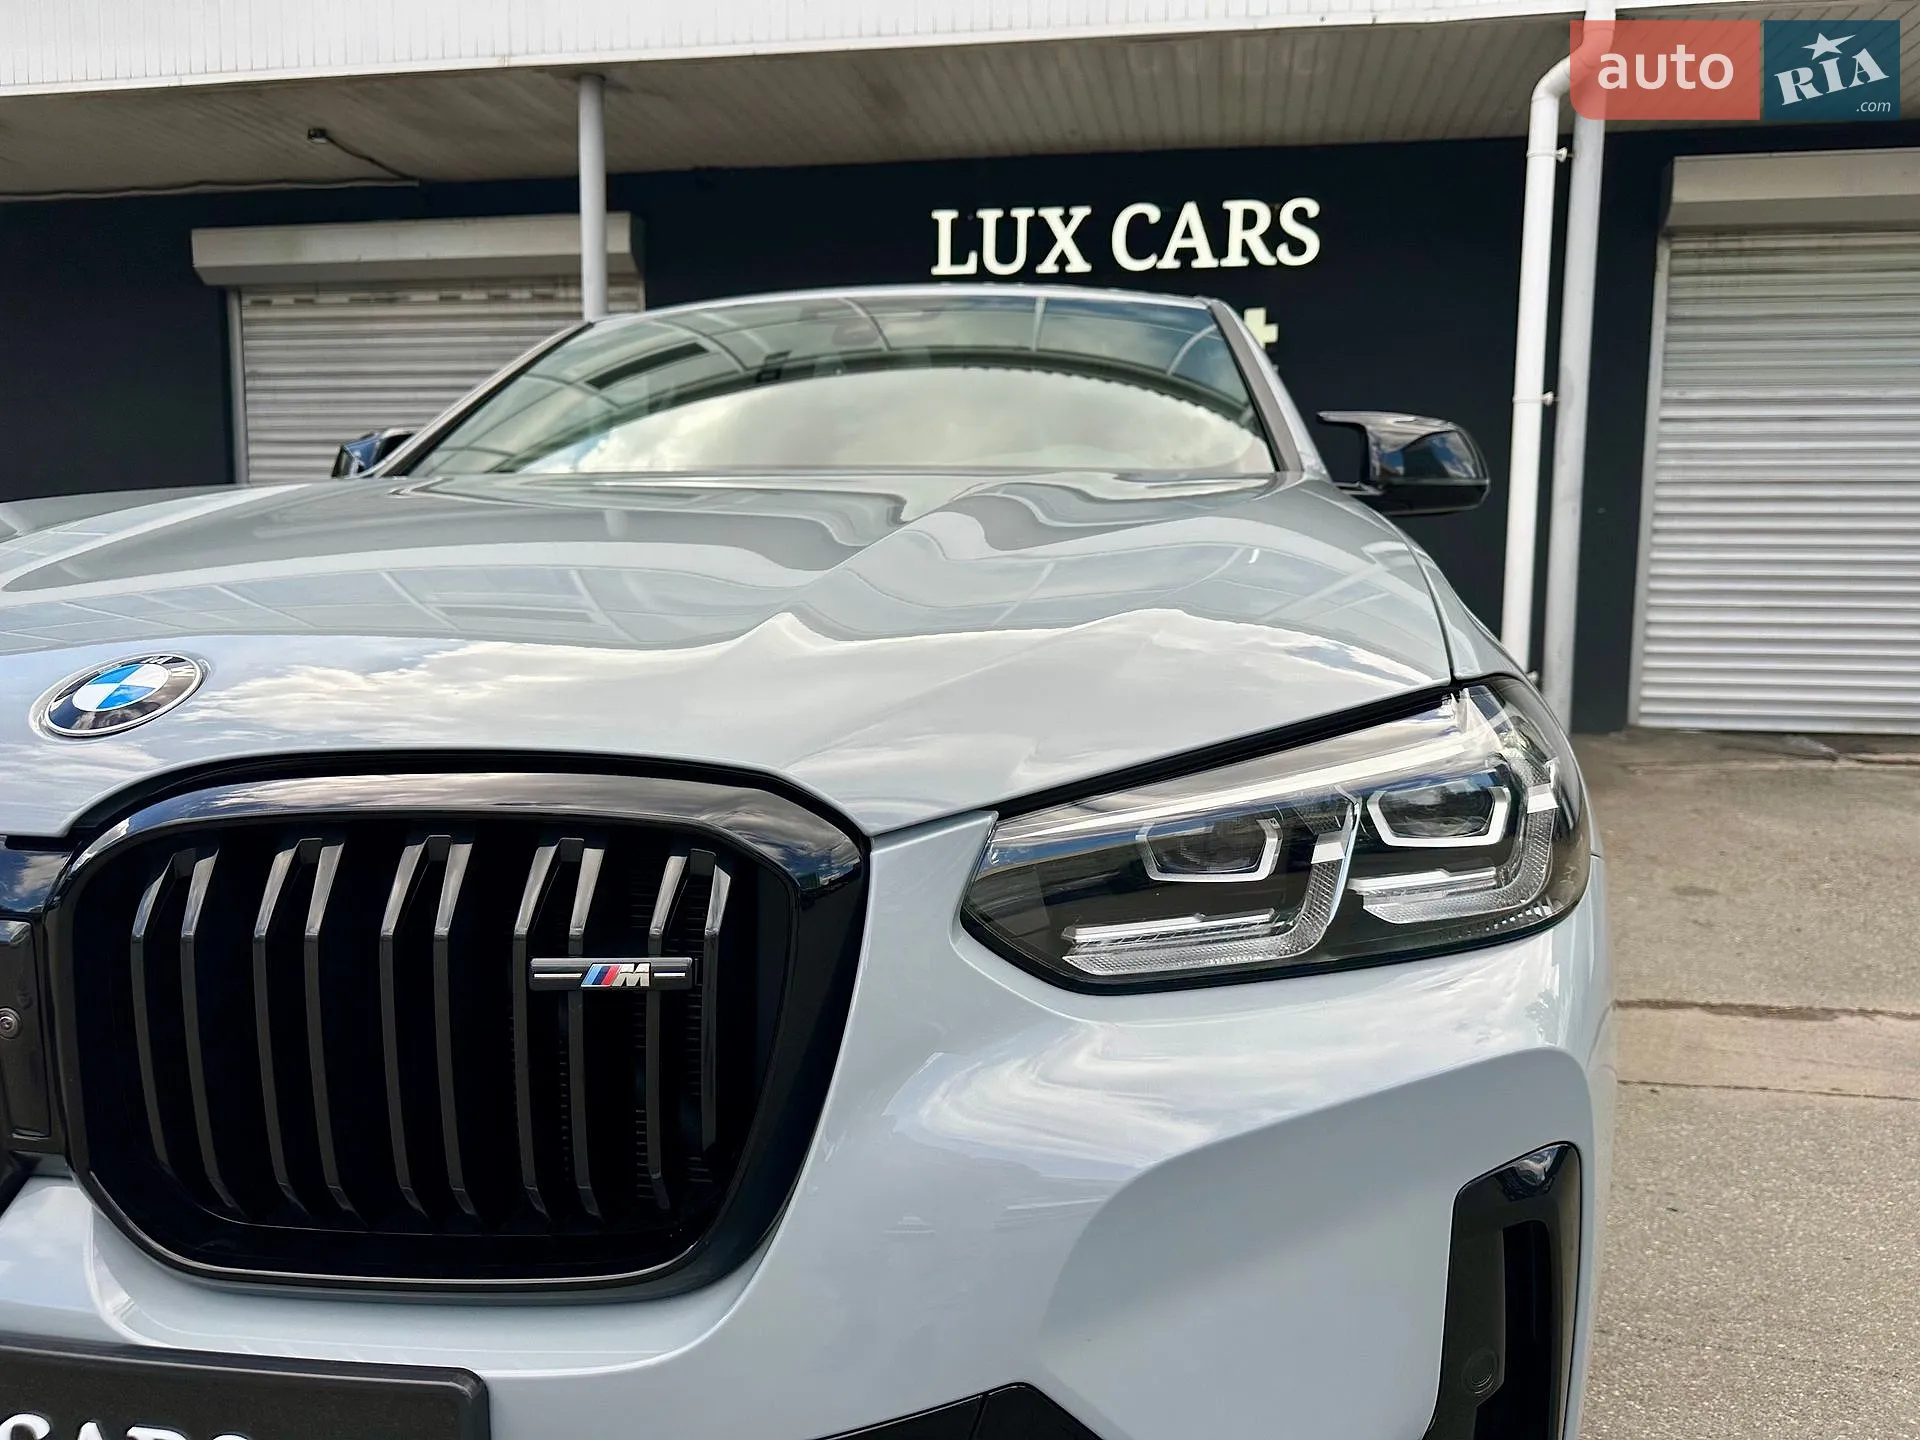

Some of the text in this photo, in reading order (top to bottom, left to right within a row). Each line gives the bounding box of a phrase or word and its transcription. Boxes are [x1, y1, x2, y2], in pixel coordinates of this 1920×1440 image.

[931, 197, 1321, 276] LUX CARS
[611, 963, 650, 987] M
